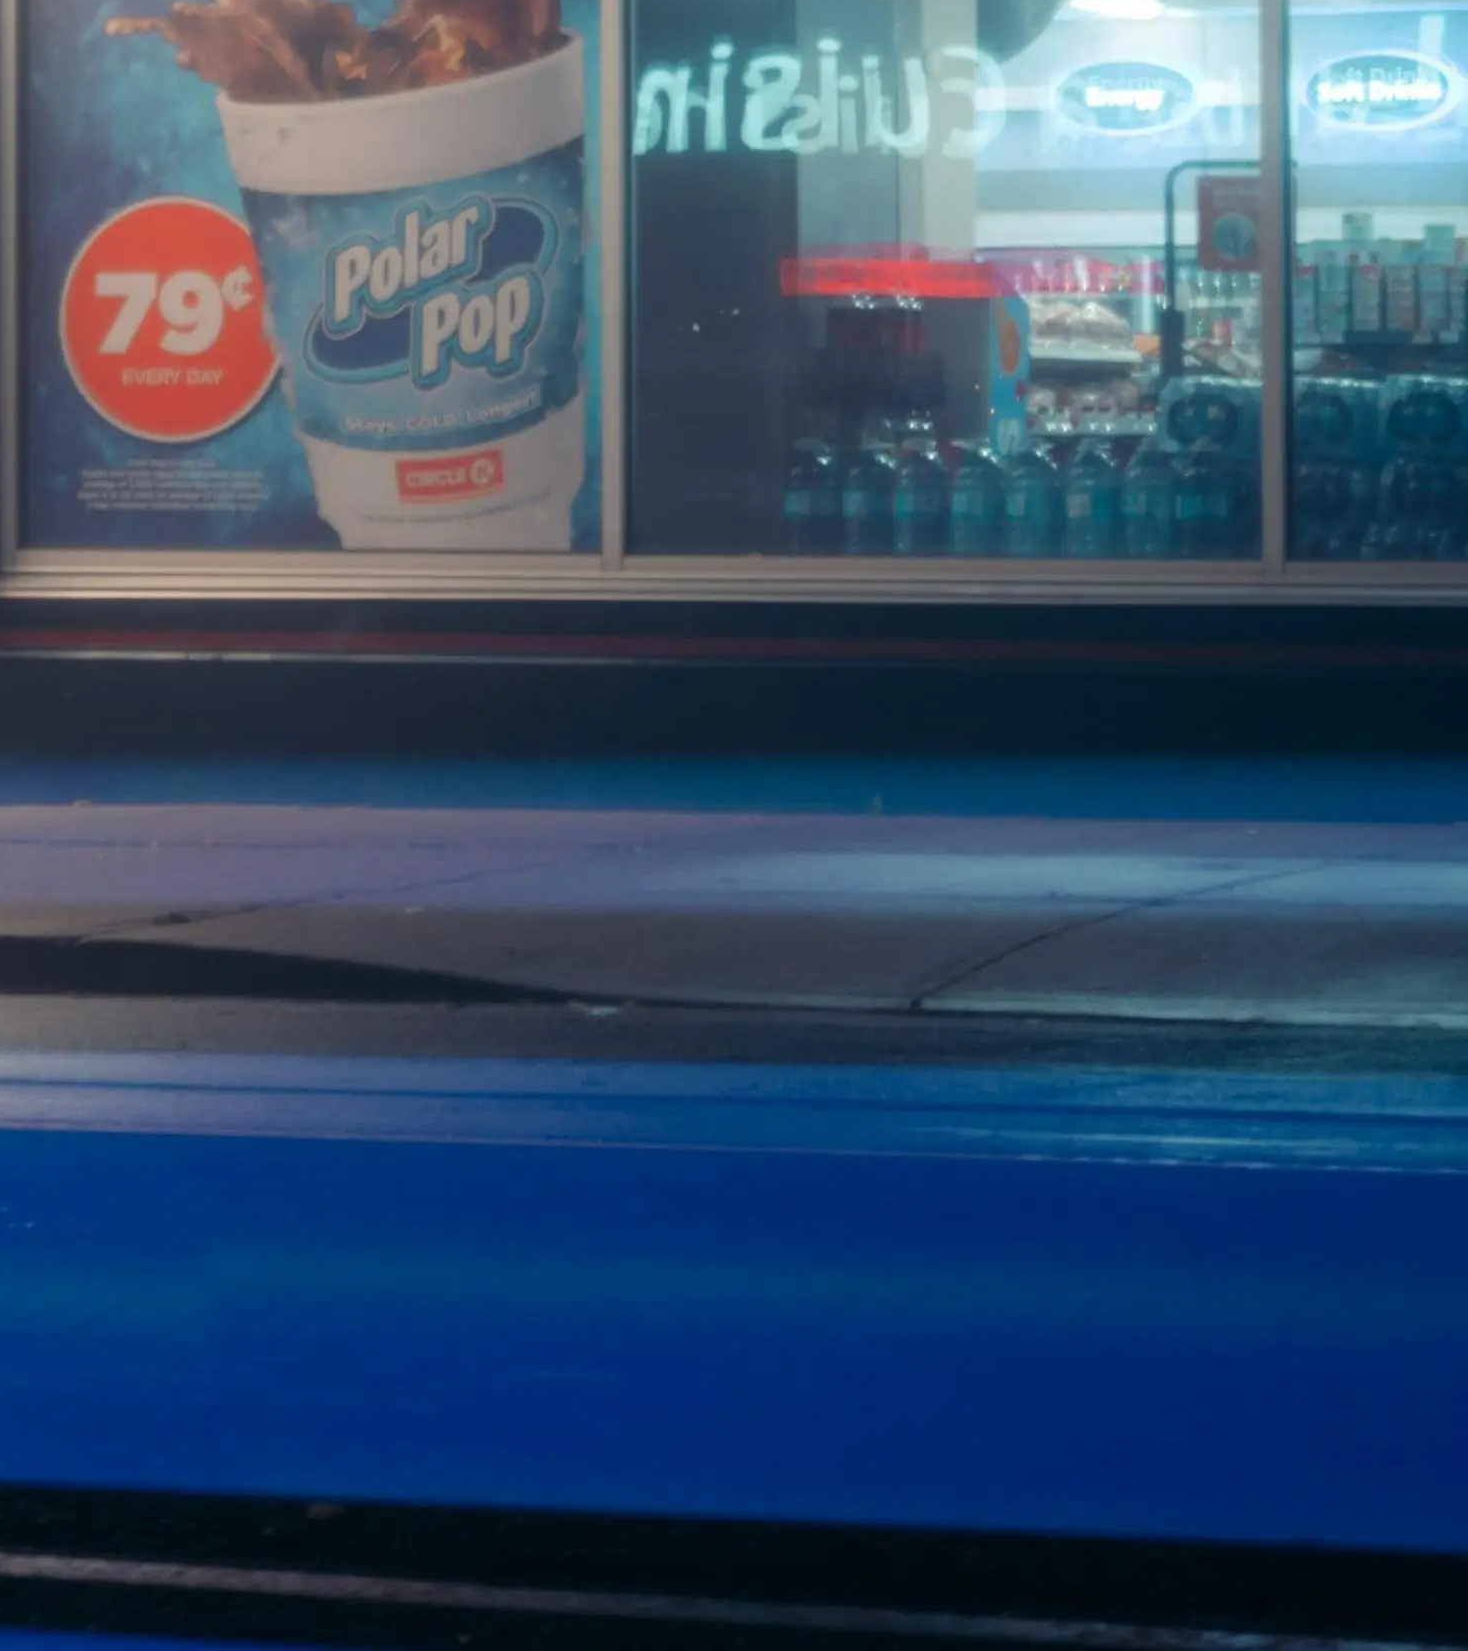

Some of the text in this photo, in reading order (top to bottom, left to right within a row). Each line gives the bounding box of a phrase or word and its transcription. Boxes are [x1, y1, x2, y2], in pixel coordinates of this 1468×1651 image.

[1085, 86, 1165, 113] Energy
[333, 204, 480, 321] Polar
[420, 275, 531, 377] Pop
[121, 367, 224, 387] EVERY DAY
[342, 415, 397, 434] Stays
[406, 412, 458, 432] COLD
[405, 466, 468, 489] CIRCLE
